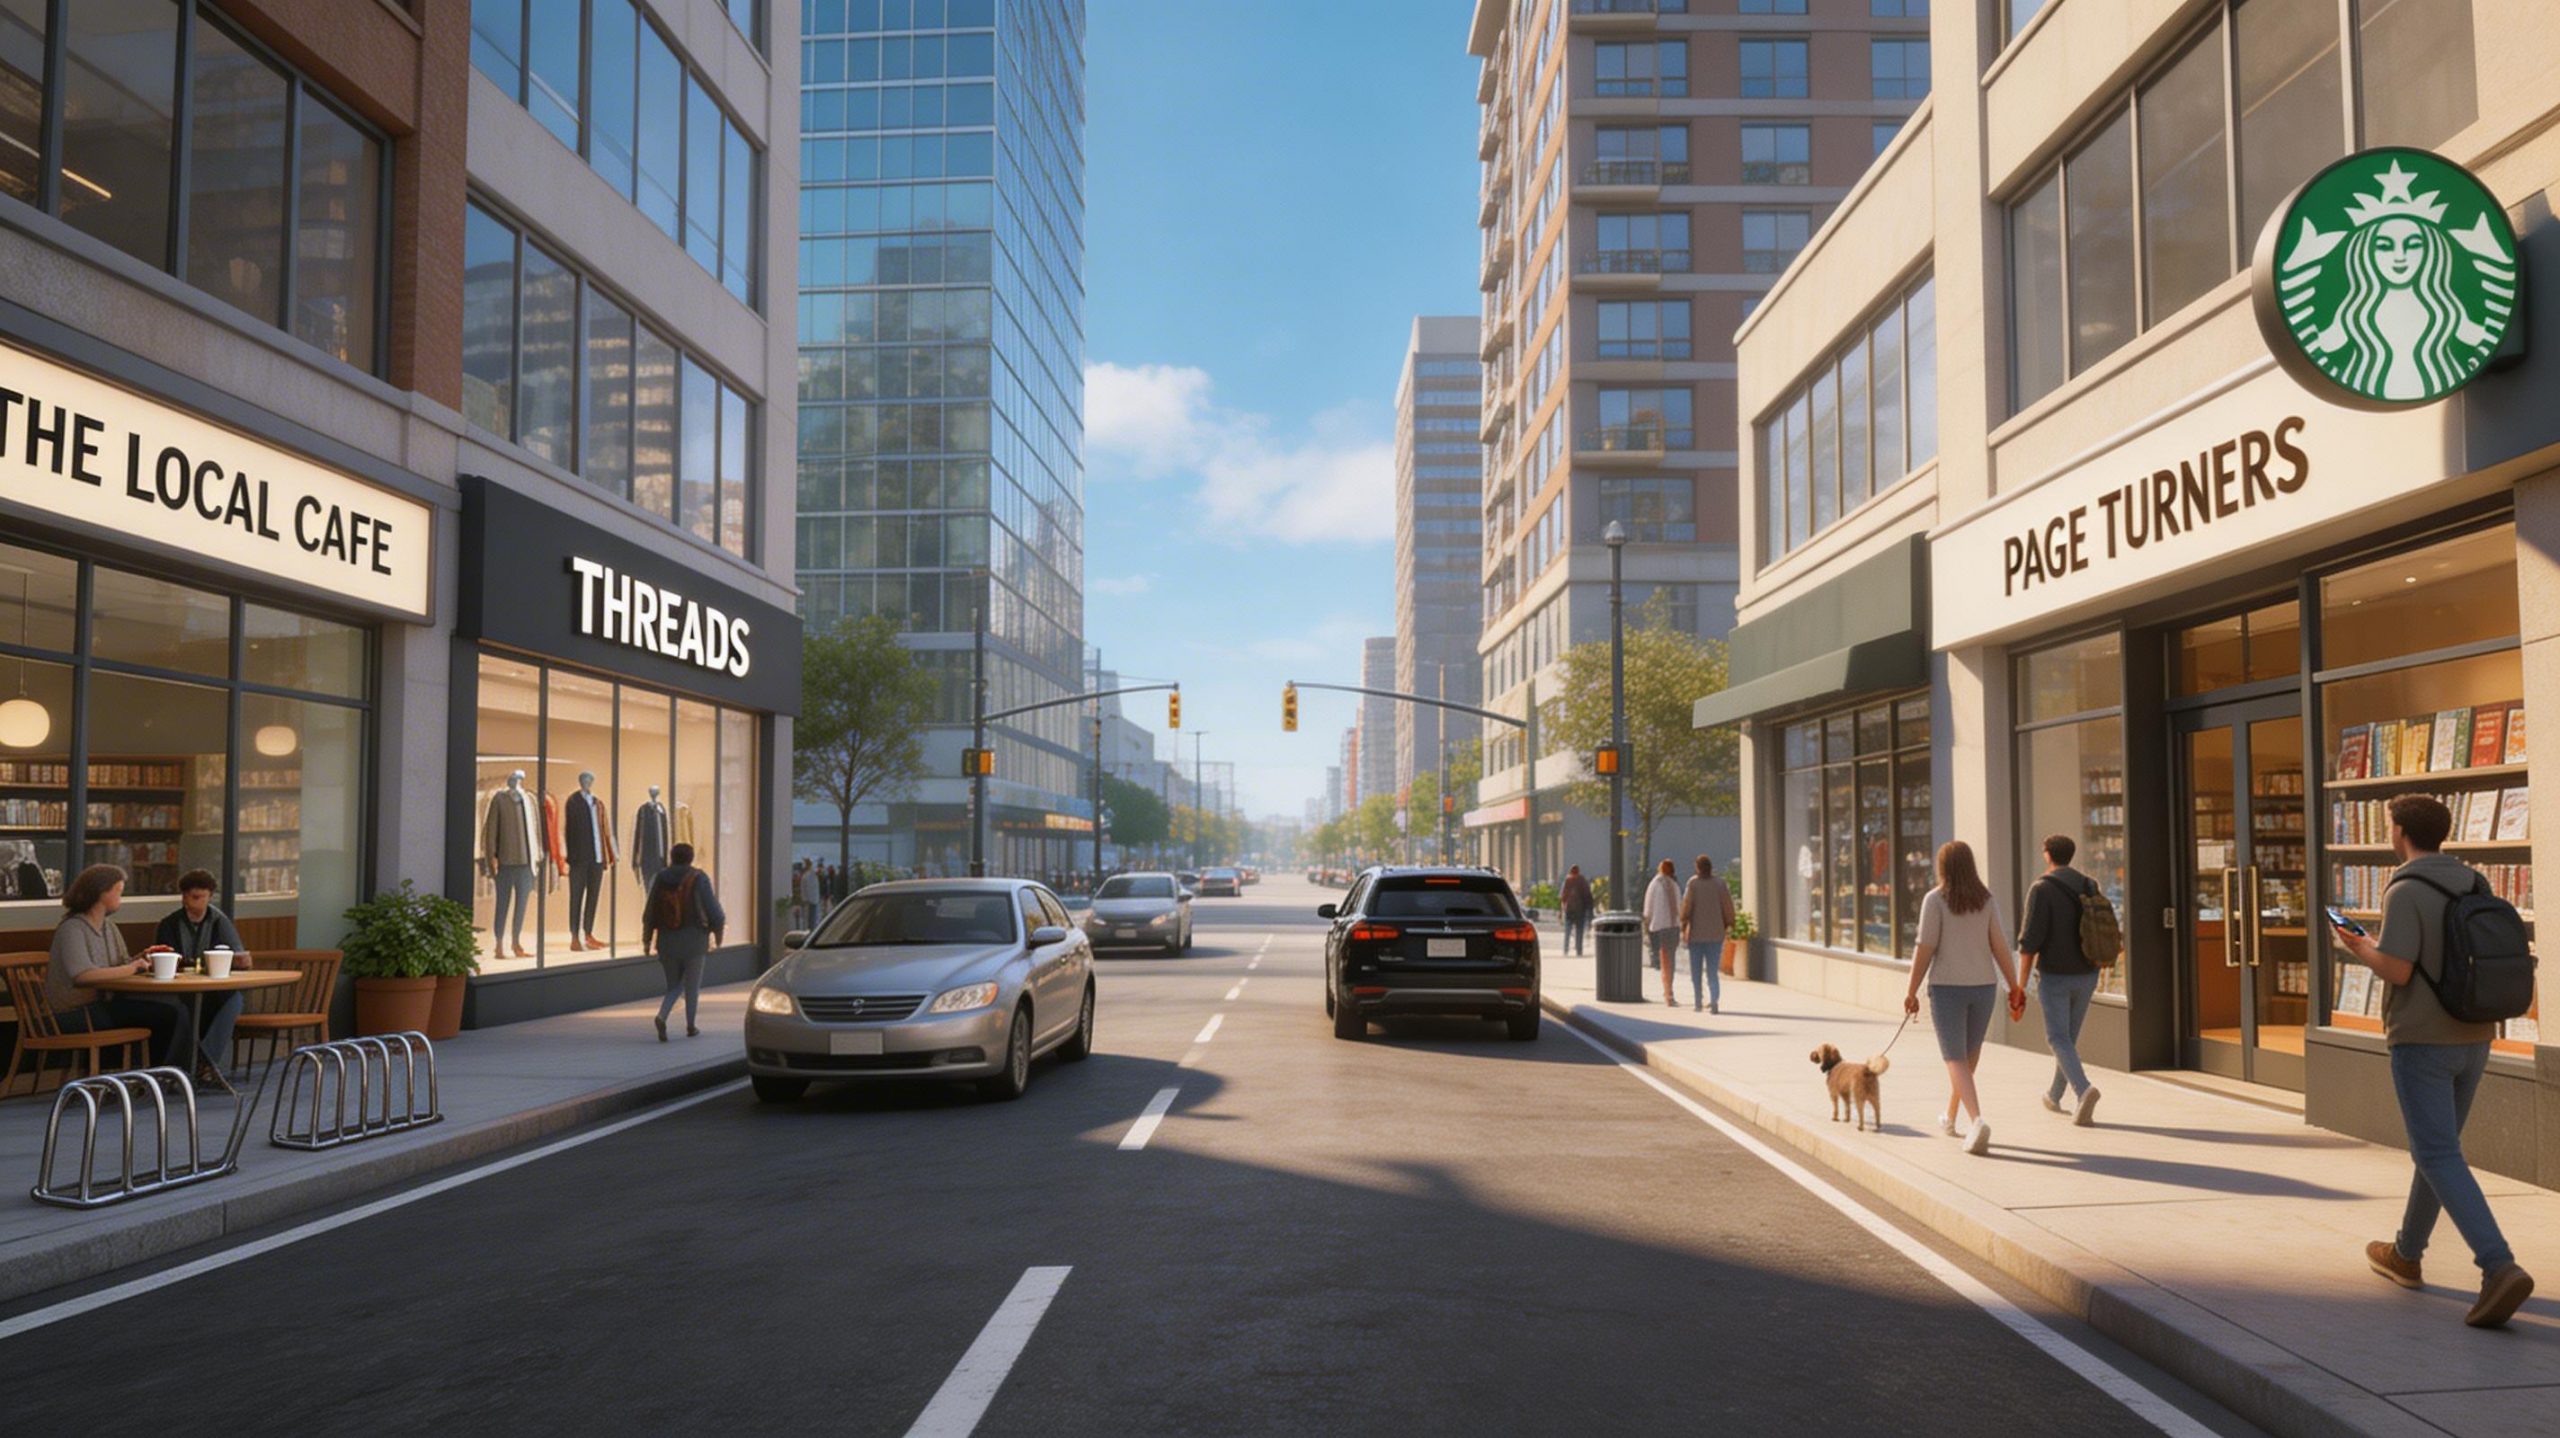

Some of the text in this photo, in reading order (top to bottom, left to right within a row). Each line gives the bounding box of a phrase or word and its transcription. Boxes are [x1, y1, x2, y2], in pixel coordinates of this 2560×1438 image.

[0, 386, 394, 577] THE LOCAL CAFE
[2004, 416, 2310, 598] PAGE TURNERS
[571, 556, 751, 678] THREADS
